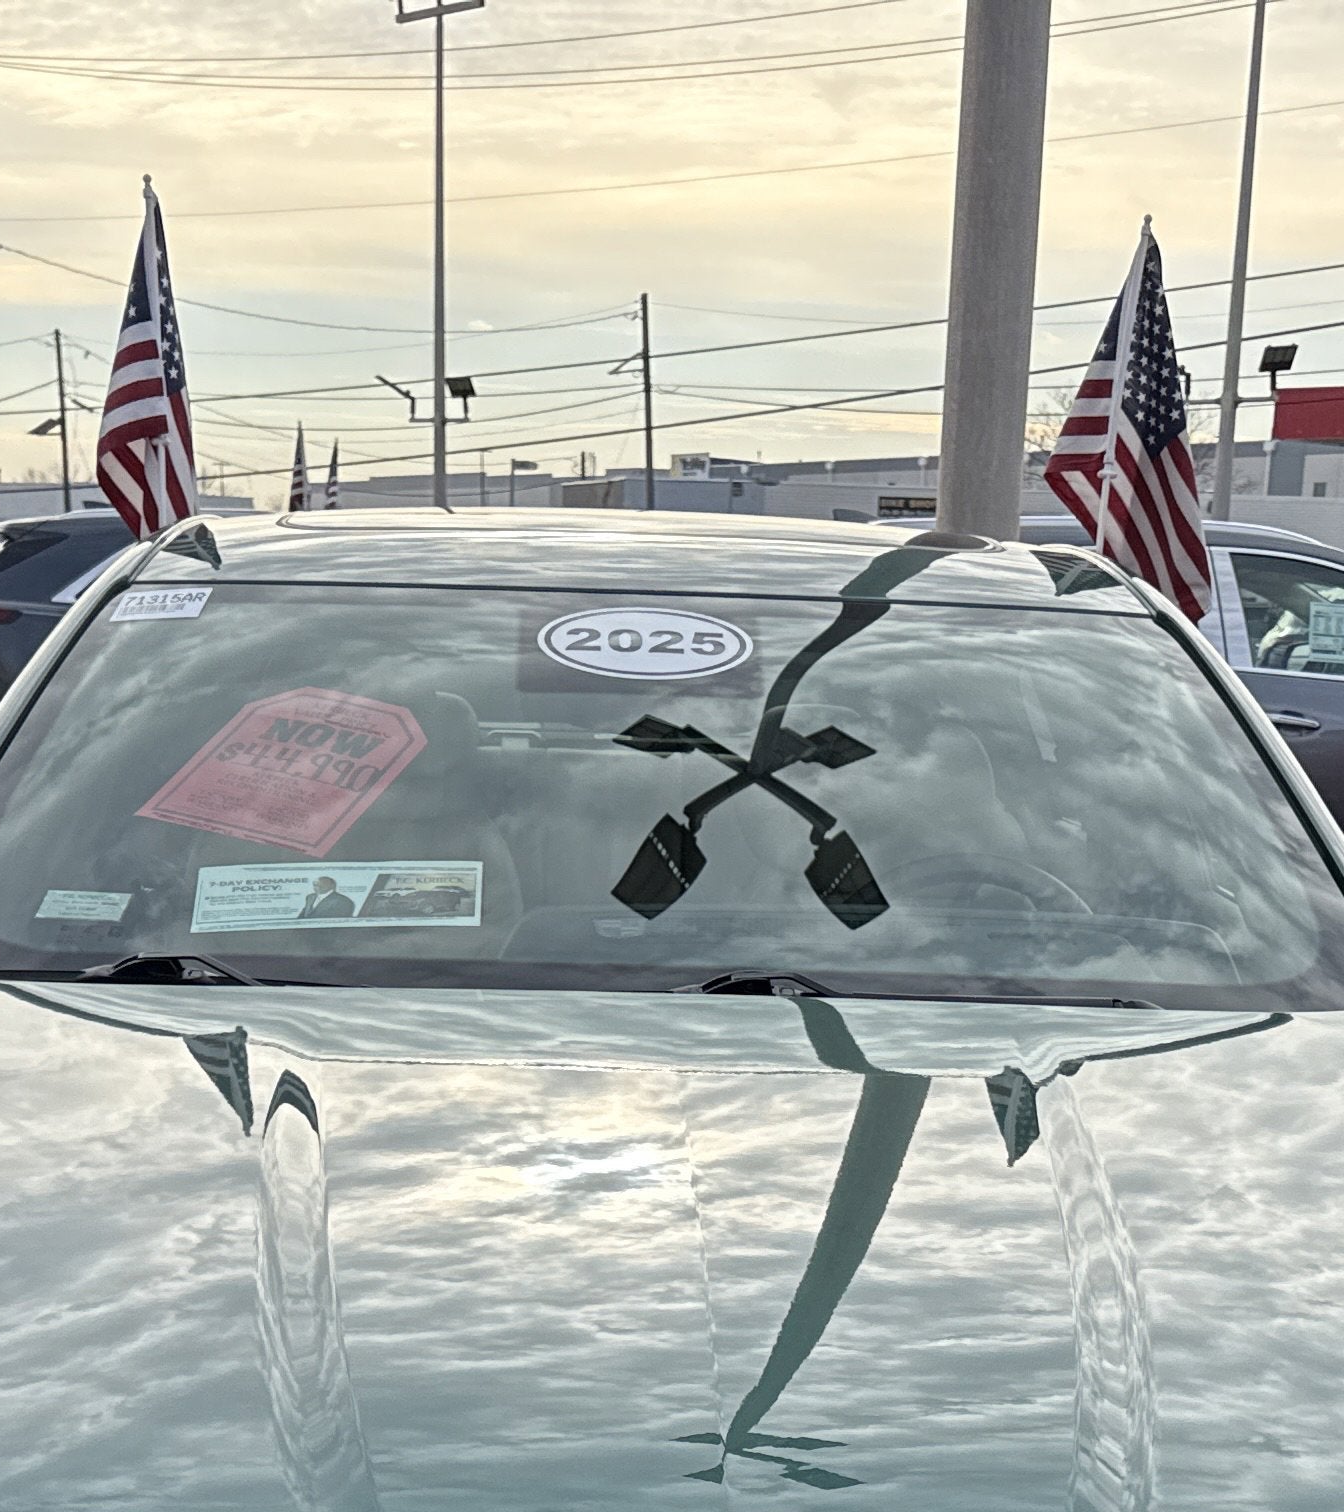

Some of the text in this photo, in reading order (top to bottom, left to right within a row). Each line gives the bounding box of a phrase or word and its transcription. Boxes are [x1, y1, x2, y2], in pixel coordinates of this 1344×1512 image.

[564, 627, 727, 656] 2025
[259, 717, 386, 760] NOW
[209, 877, 309, 888] 7-DAY EXCHANGE
